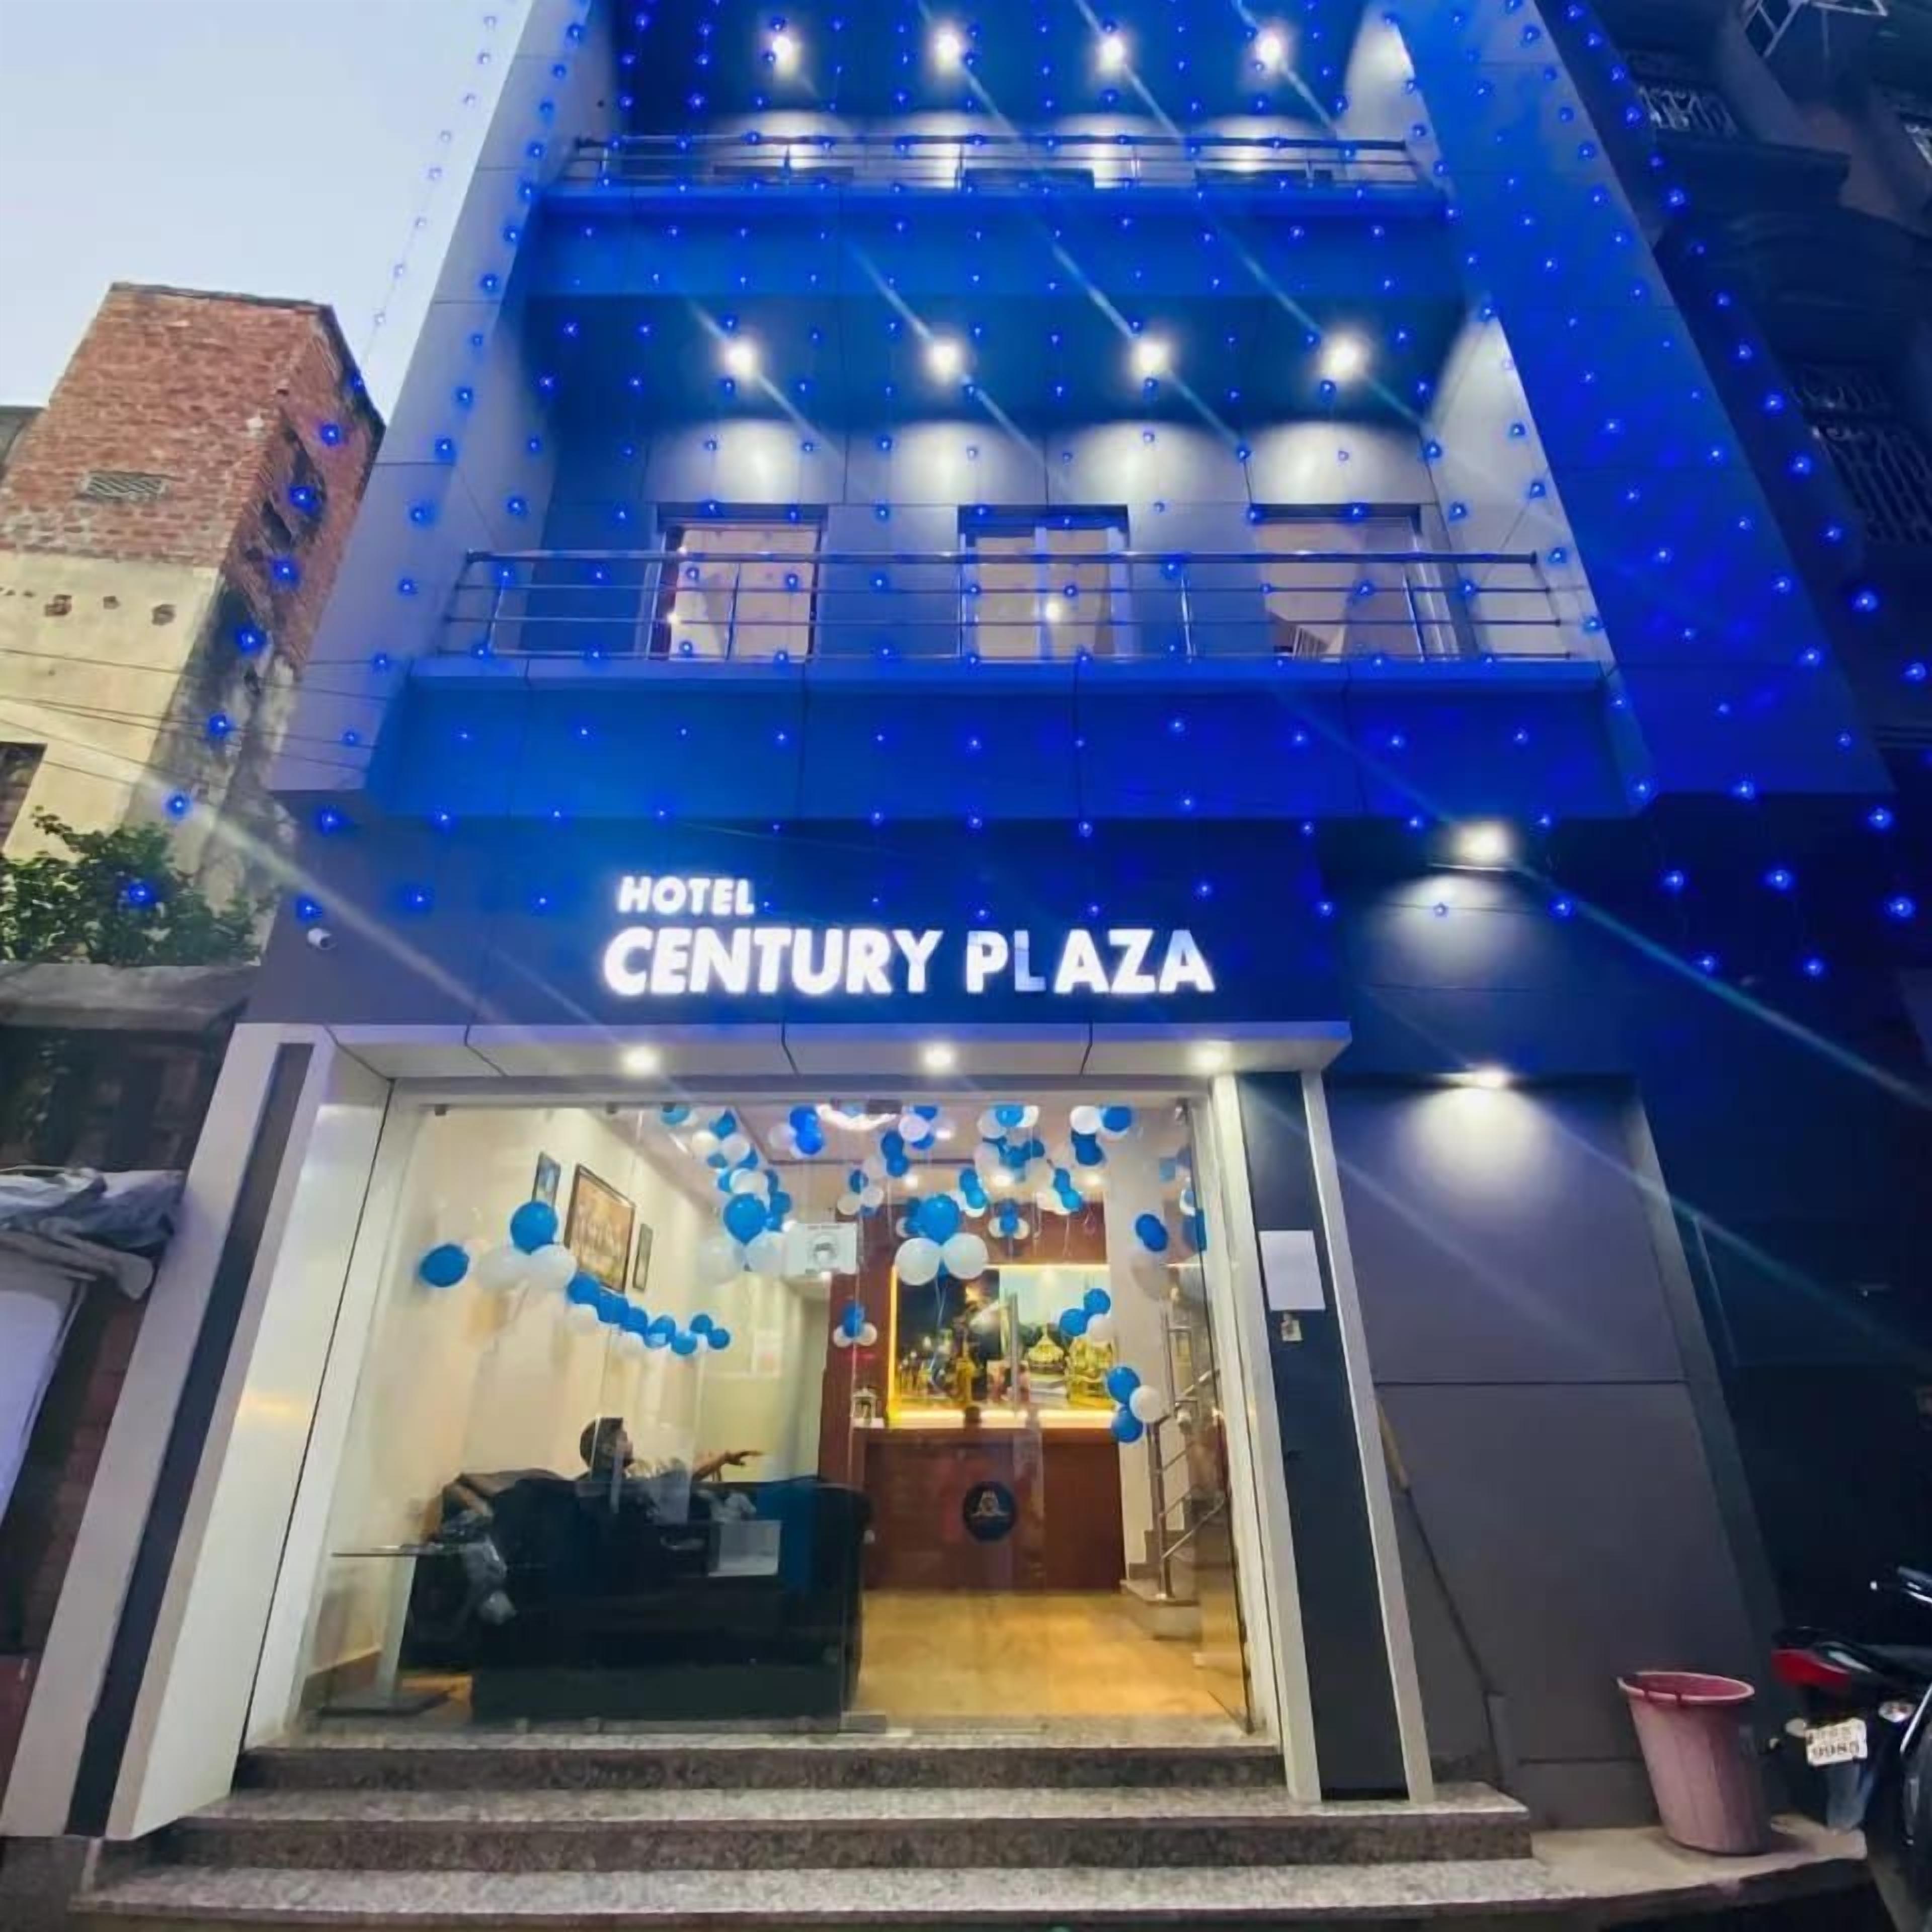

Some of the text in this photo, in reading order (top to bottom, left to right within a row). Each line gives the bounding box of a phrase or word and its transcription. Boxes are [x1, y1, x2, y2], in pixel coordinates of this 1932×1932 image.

[616, 875, 755, 916] HOTEL
[602, 926, 1215, 996] CENTURY PLAZA
